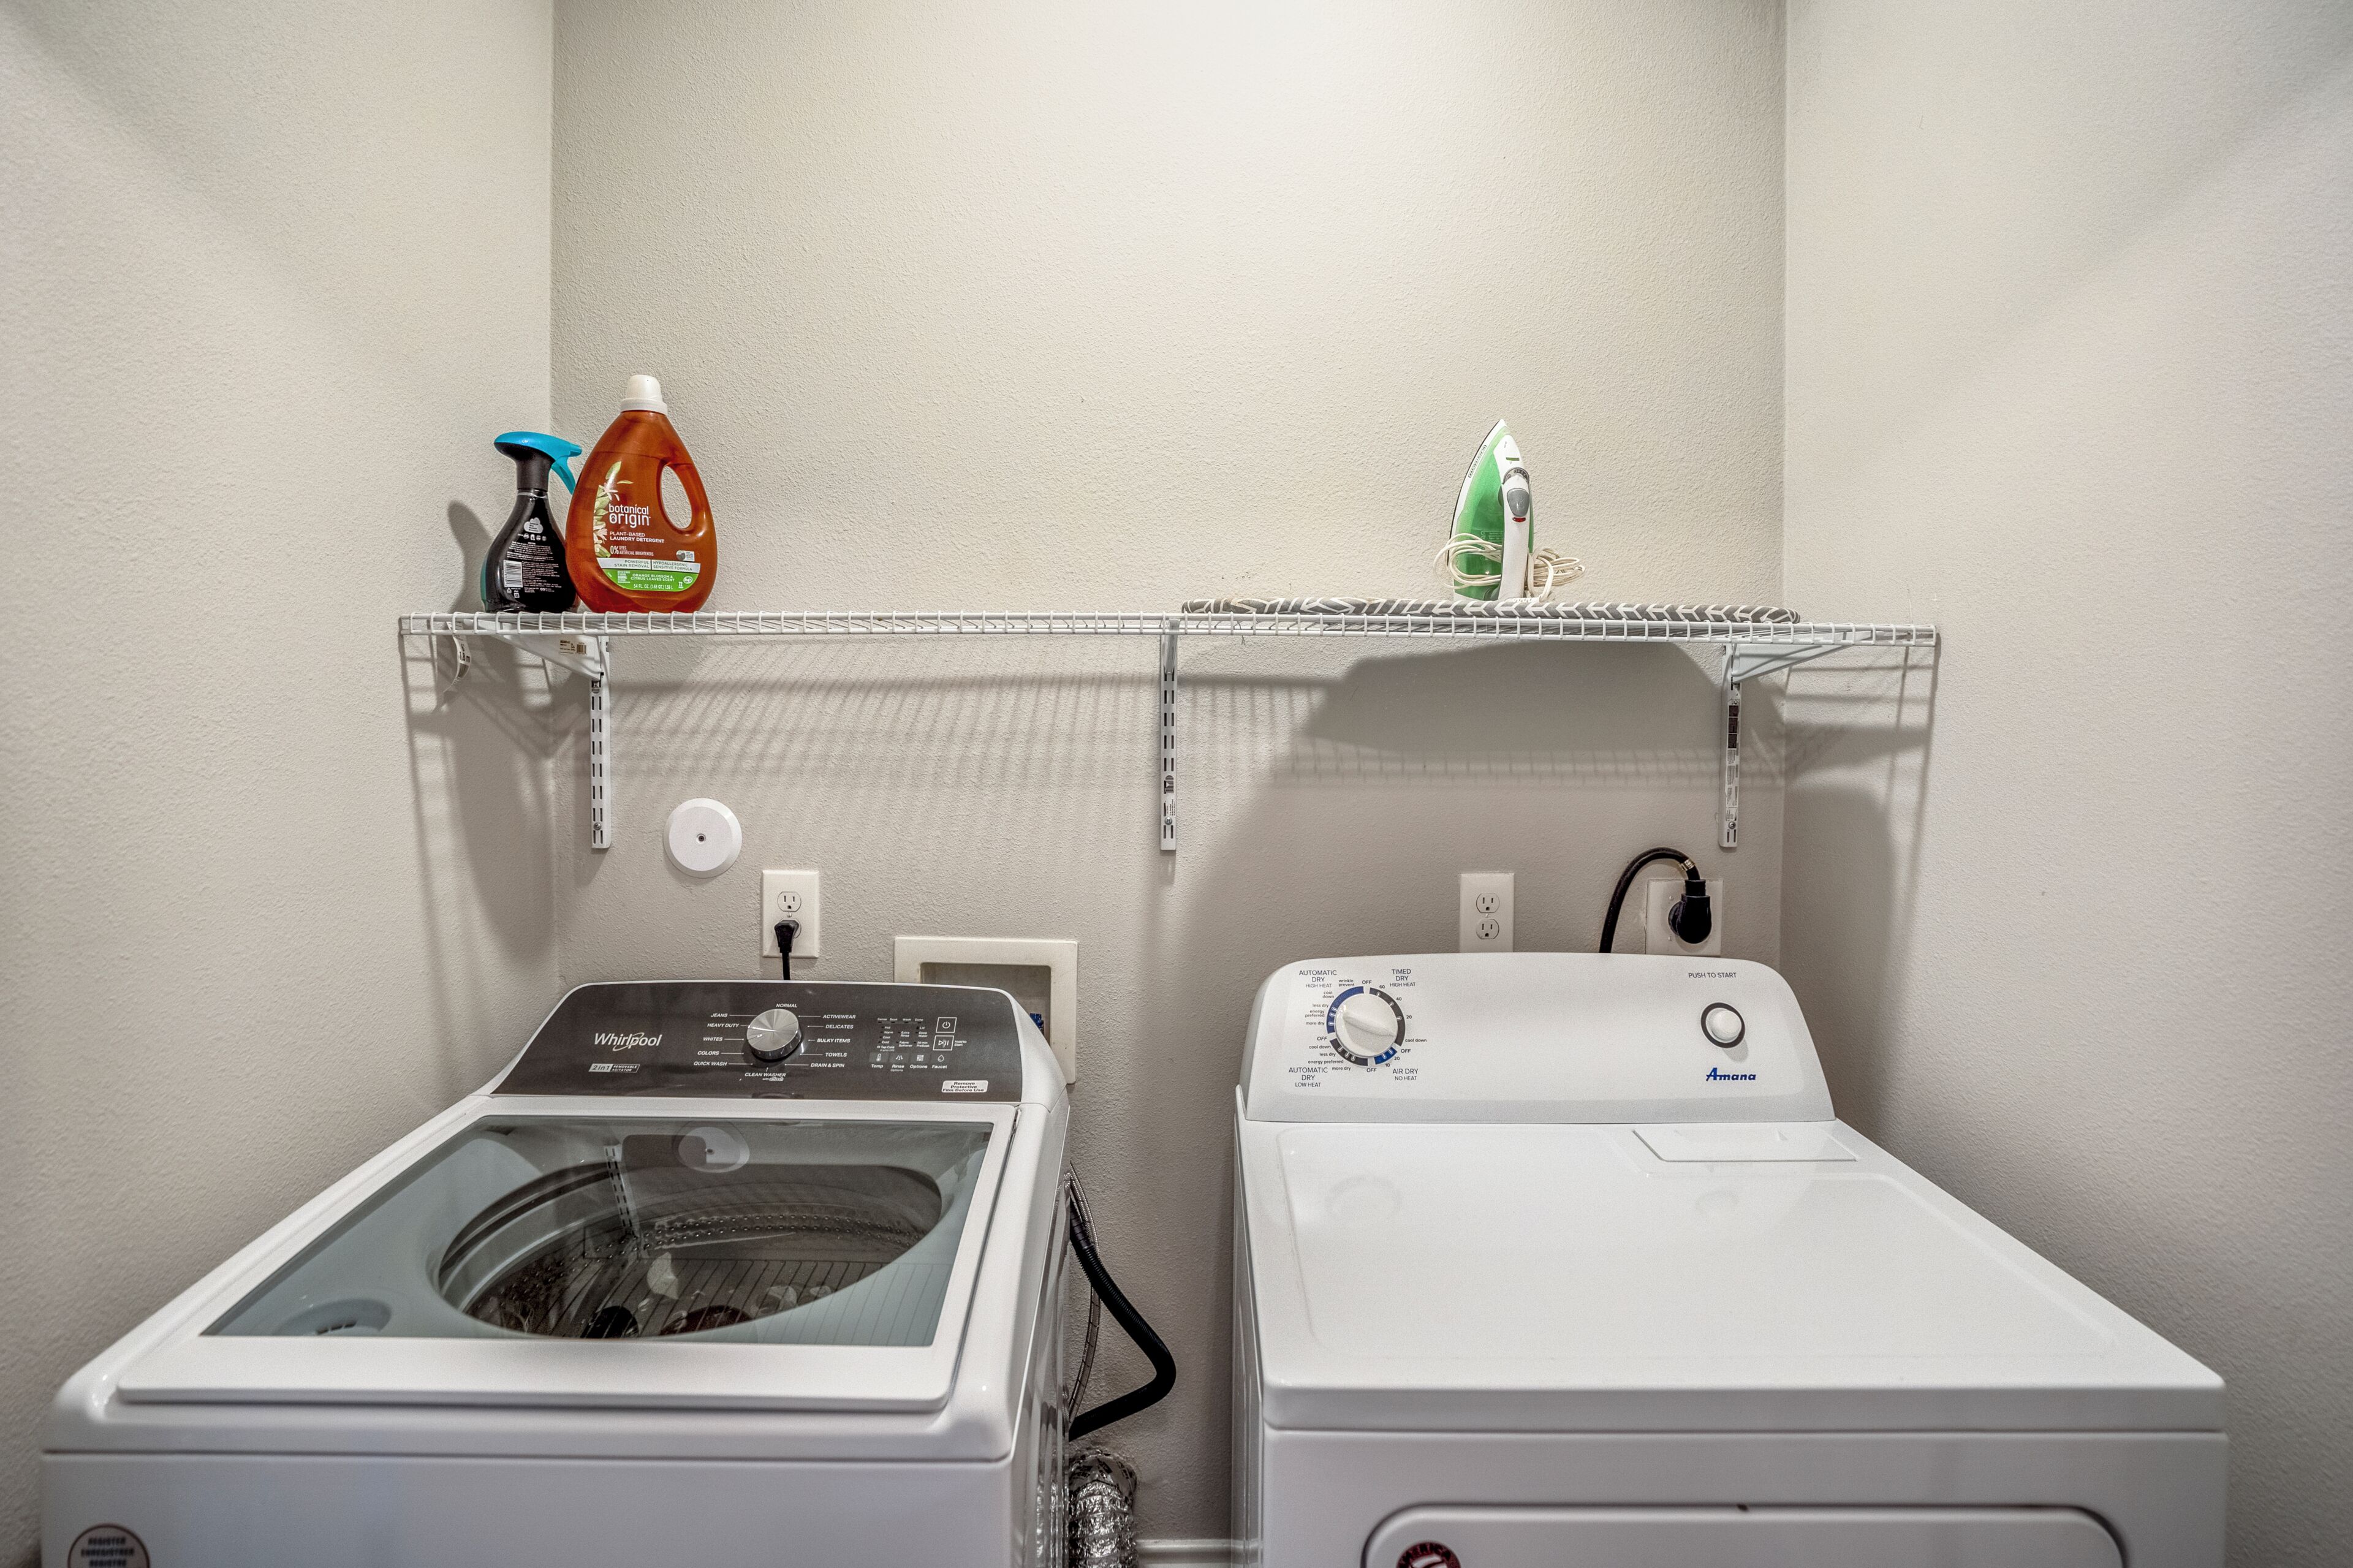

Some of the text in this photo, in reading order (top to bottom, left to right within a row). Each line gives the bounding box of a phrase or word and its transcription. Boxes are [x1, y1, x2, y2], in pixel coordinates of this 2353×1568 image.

[609, 503, 648, 515] botanical
[609, 513, 649, 528] origin
[594, 1032, 662, 1050] Whirlpool
[1706, 1067, 1756, 1081] Amana
